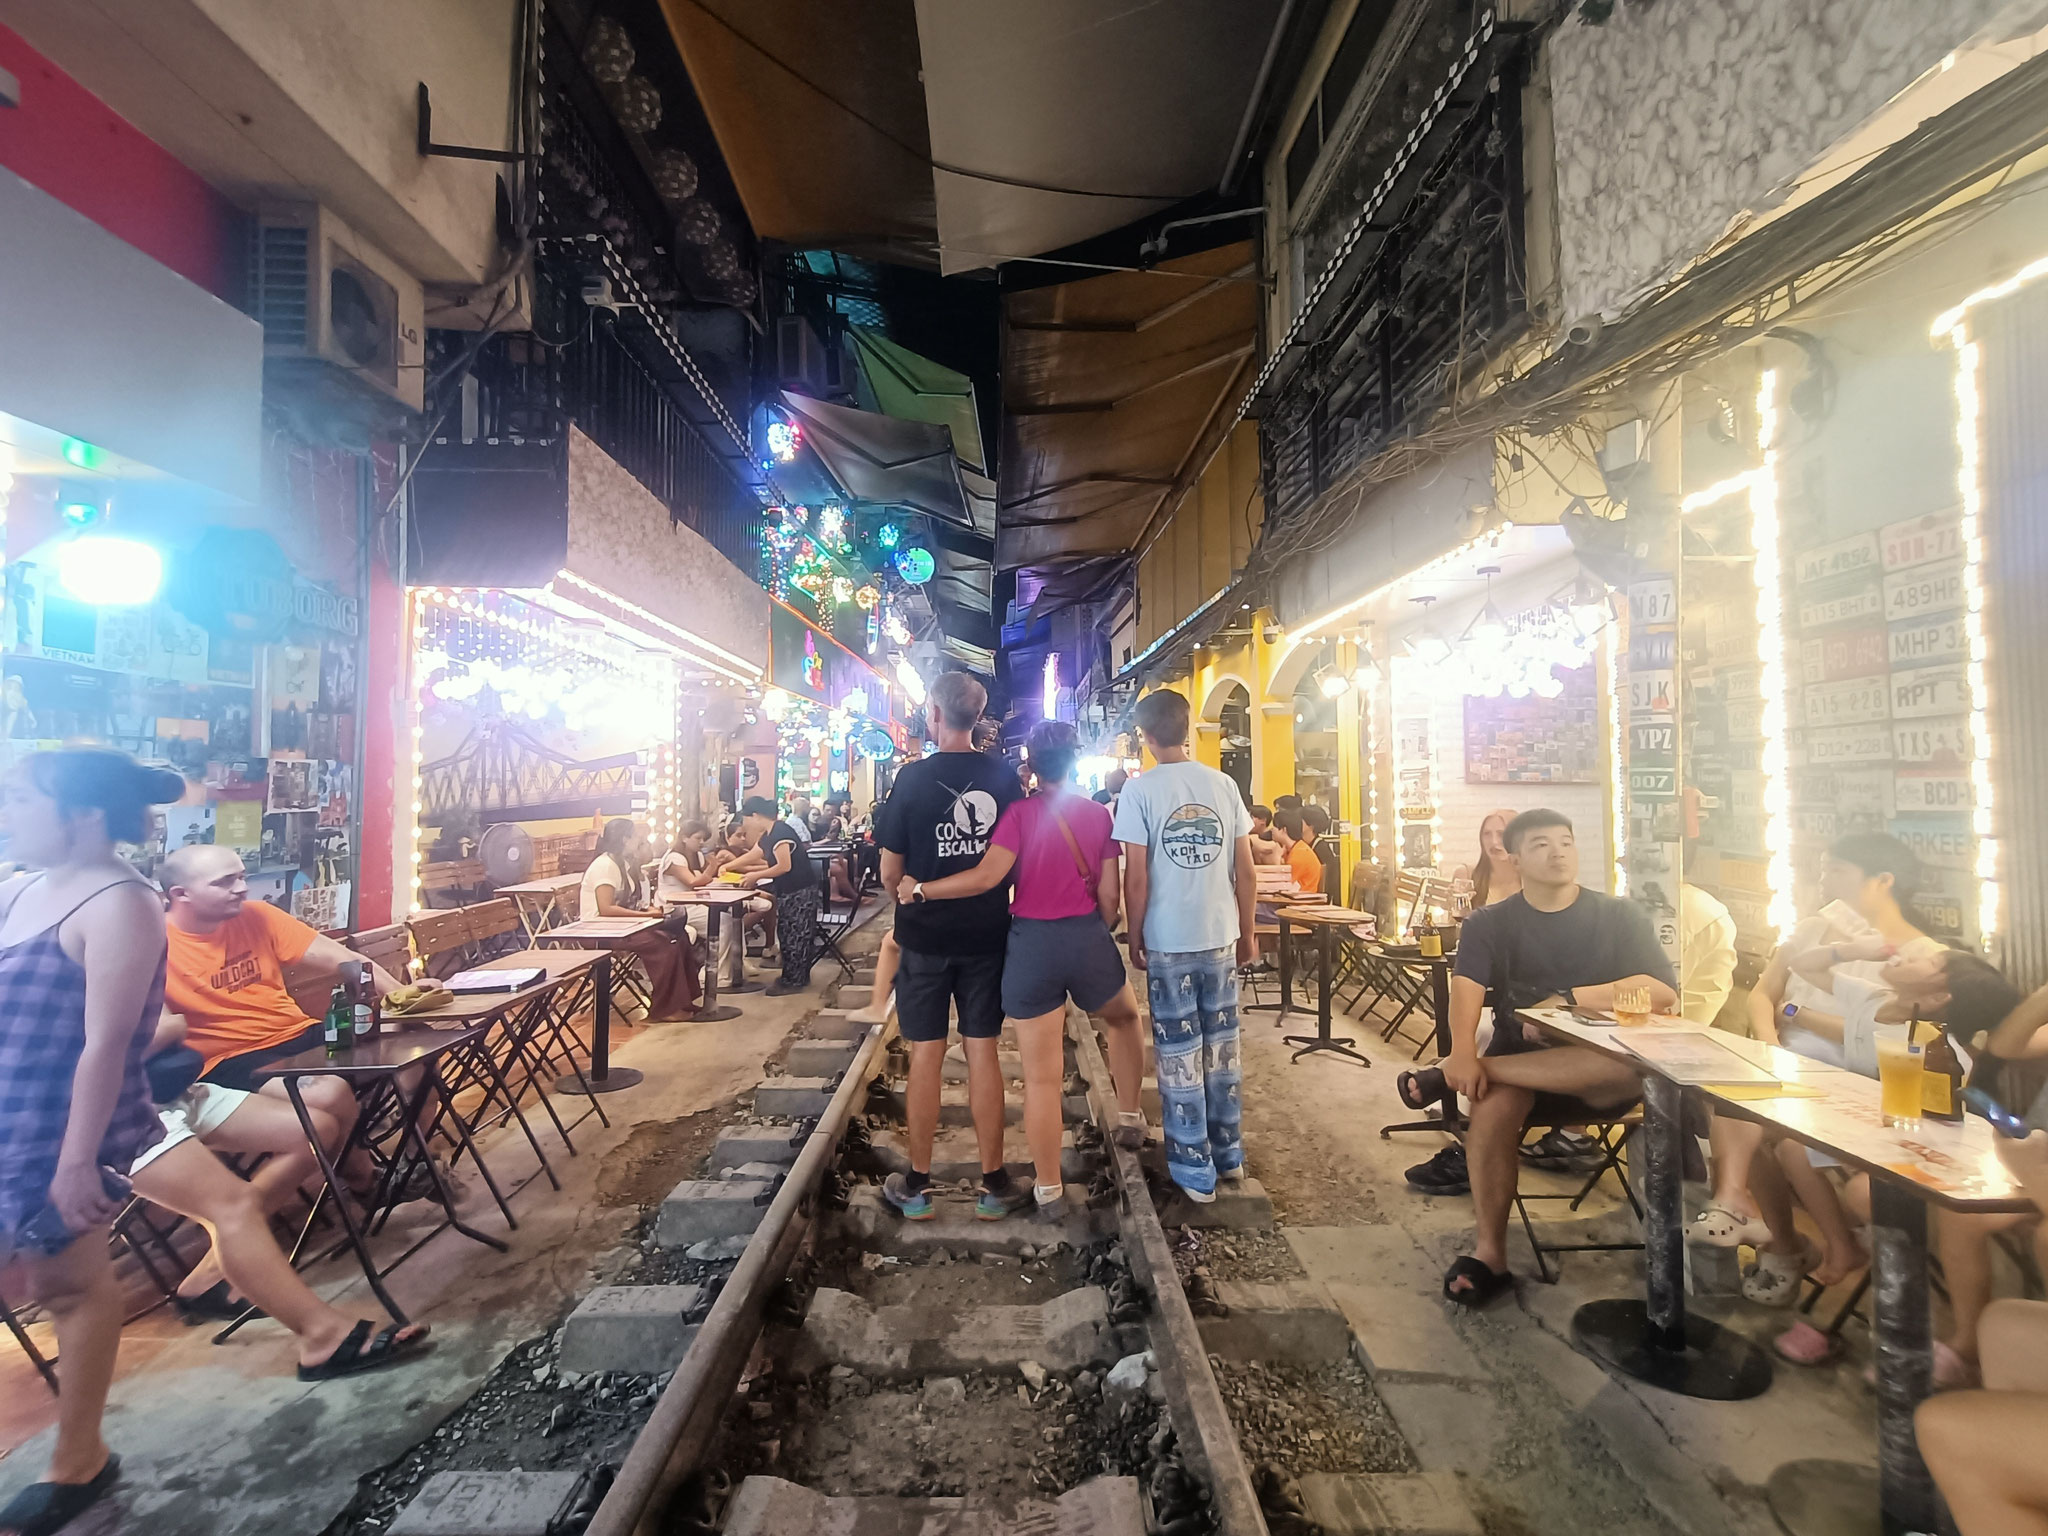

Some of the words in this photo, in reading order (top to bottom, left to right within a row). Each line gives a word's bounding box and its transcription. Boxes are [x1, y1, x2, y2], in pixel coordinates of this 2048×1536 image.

[401, 322, 417, 345] LG
[1895, 629, 1940, 657] MHP
[42, 647, 96, 664] VIETNAM
[1632, 681, 1669, 706] SJK
[1897, 681, 1938, 707] RPT
[1637, 728, 1672, 750] YPZ
[1899, 731, 1930, 757] TXS
[1632, 774, 1668, 789] 007
[1171, 845, 1197, 858] KOH
[1187, 853, 1211, 865] TAO
